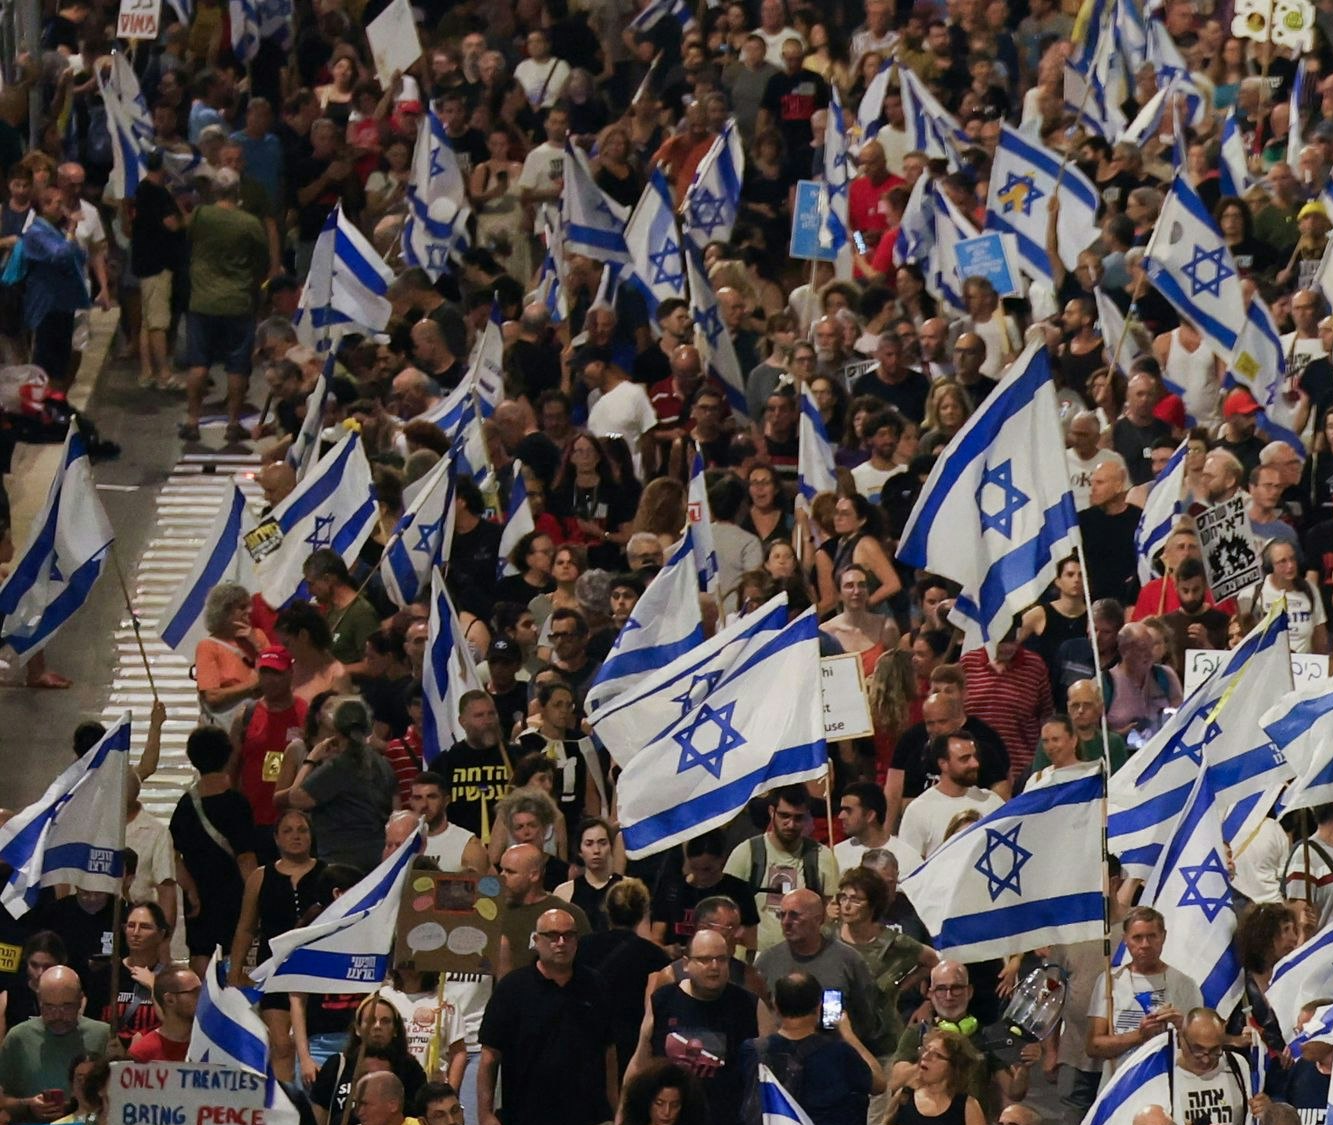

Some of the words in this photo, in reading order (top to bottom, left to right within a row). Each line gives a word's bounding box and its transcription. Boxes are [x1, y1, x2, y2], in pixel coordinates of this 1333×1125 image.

[452, 765, 509, 784] הדחה
[119, 1068, 169, 1090] ONLY
[175, 1068, 260, 1092] TREATIES
[1187, 1088, 1224, 1109] אתה
